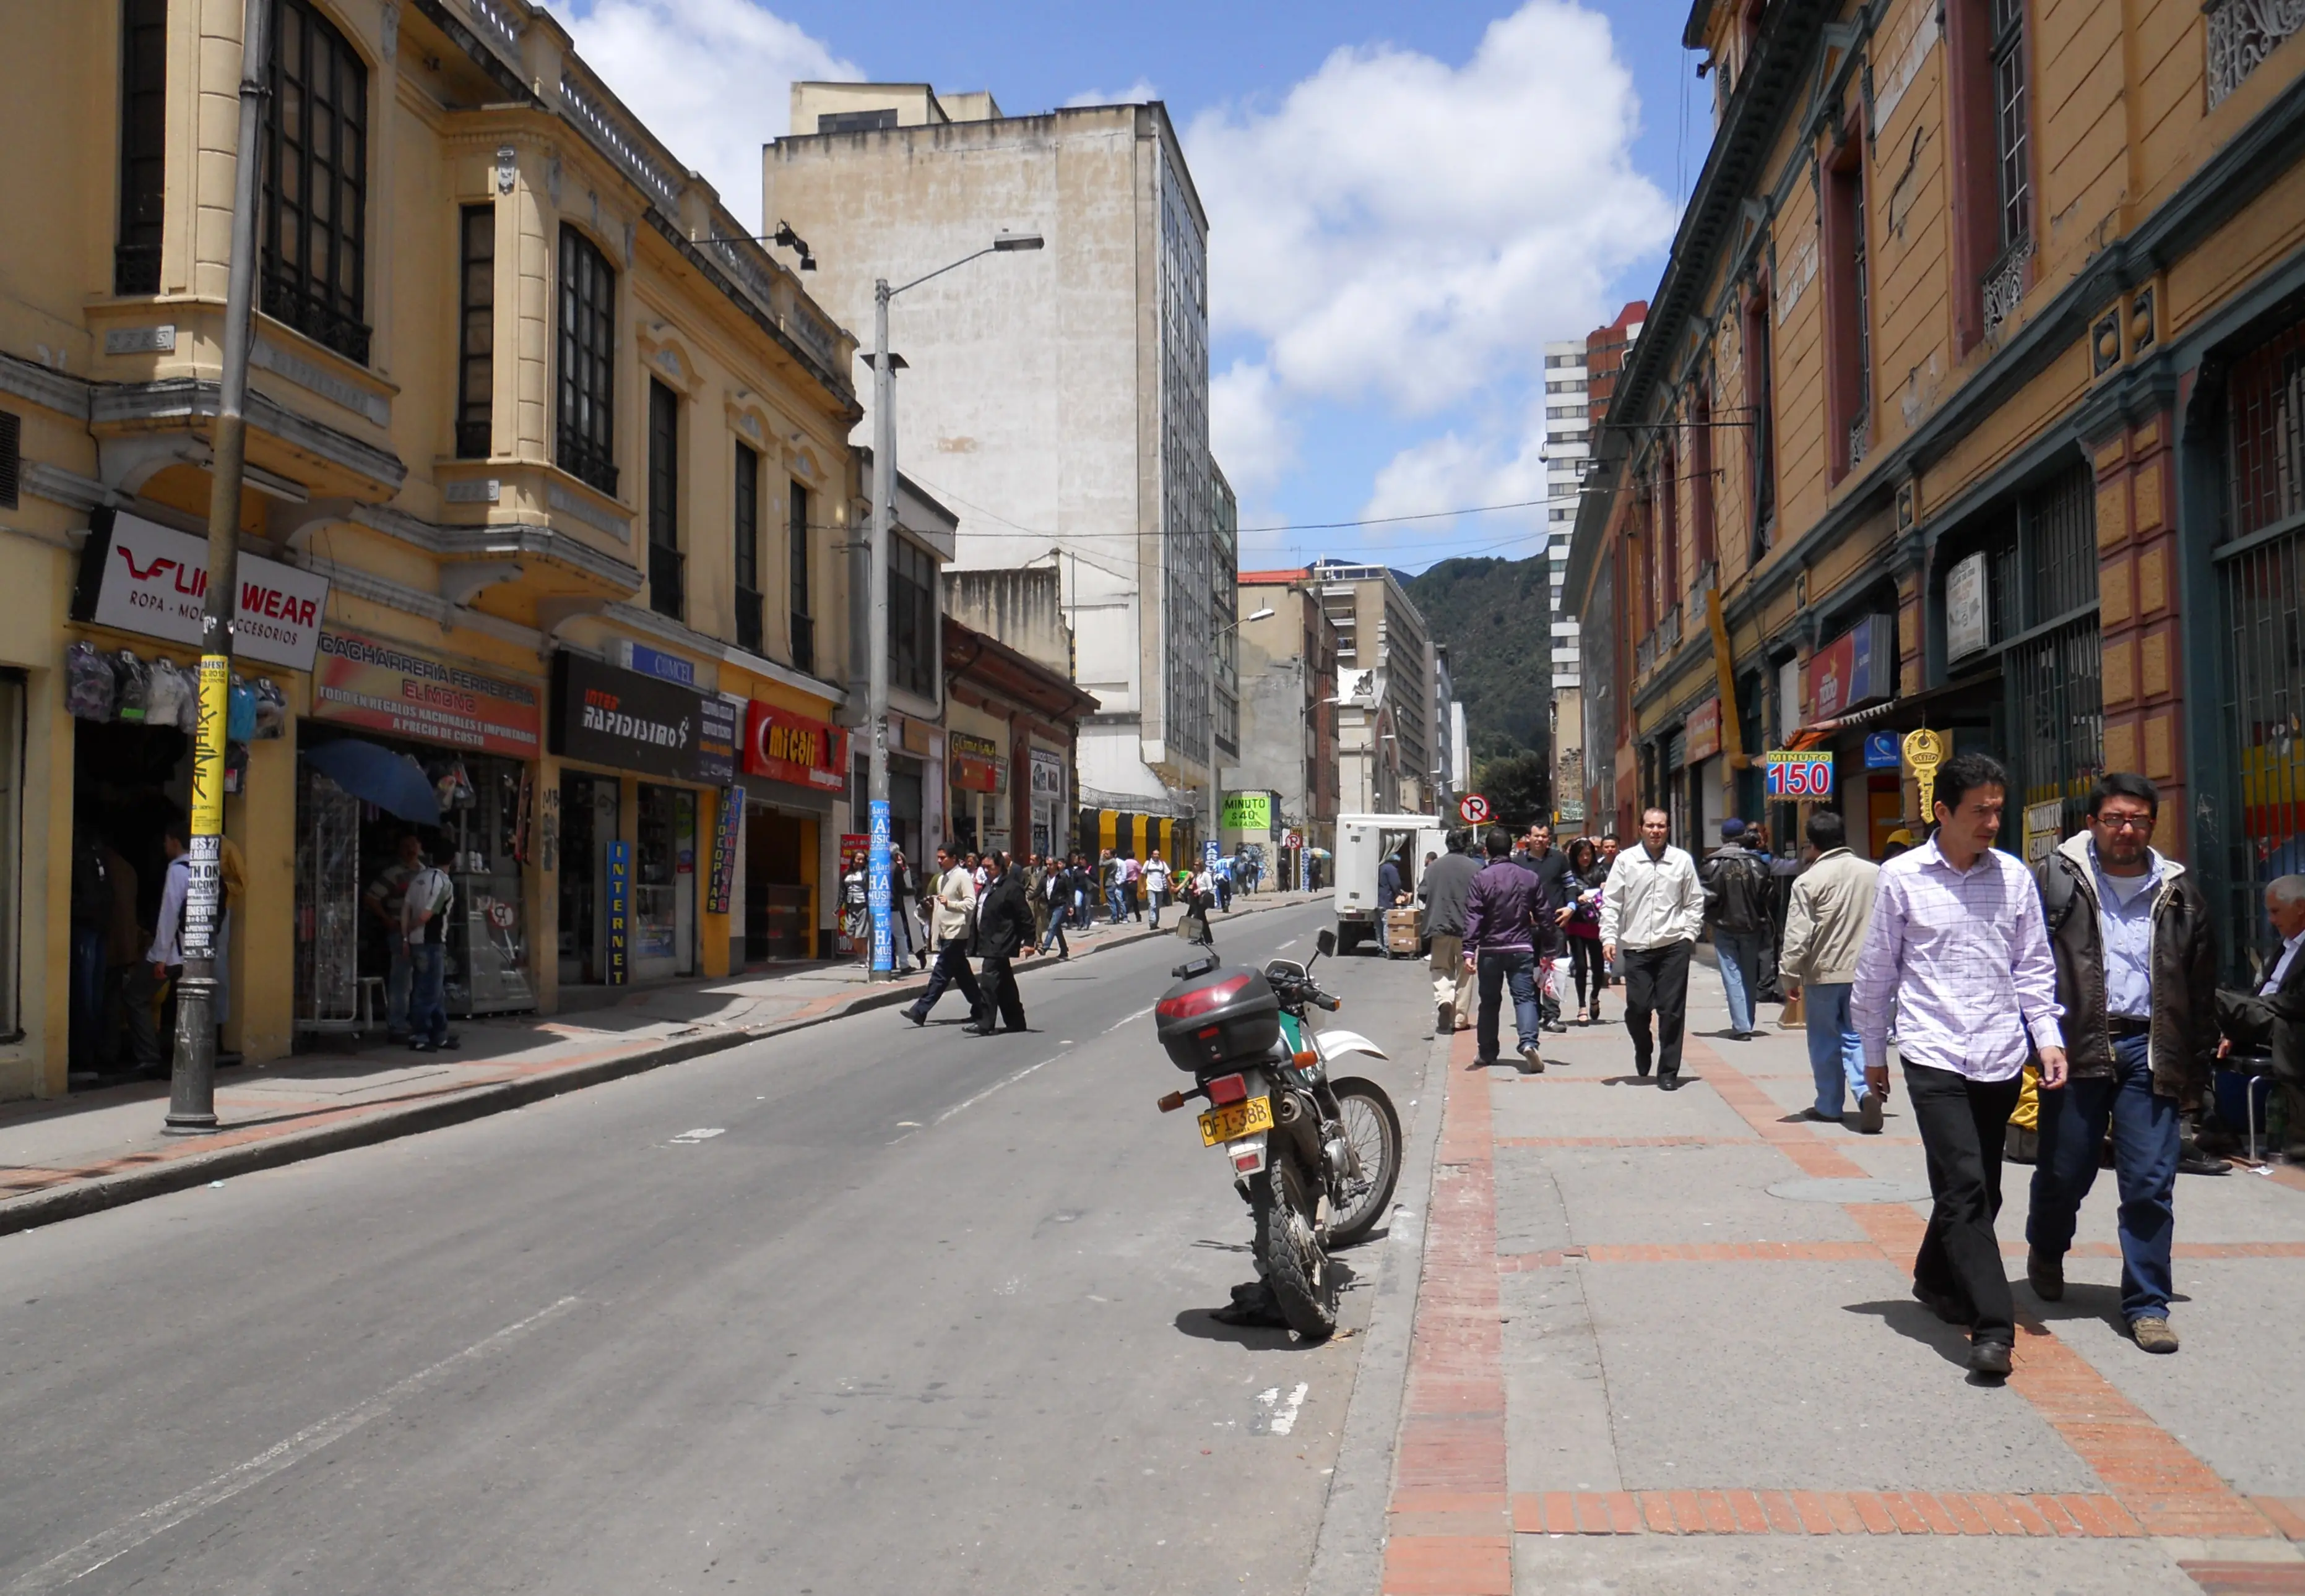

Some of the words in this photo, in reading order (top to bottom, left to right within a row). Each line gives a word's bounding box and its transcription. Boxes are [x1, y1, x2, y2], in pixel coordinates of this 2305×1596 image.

[130, 590, 163, 611] ROPA
[236, 618, 298, 646] CCESORIOS
[241, 582, 316, 628] WEAR
[319, 686, 350, 703] TODO
[354, 694, 368, 707] EN
[370, 698, 417, 717] REGALOS
[419, 708, 475, 731] NACIONALES
[484, 723, 537, 744] IMPORTADOS
[425, 684, 477, 715] MONO
[393, 718, 400, 730] A
[402, 720, 438, 737] PRECIO
[441, 727, 452, 739] DE
[454, 730, 484, 746] COSTO
[1770, 753, 1830, 762] MINUTO
[1768, 762, 1830, 795] 150
[1225, 798, 1265, 809] MINUTO
[708, 785, 731, 911] FOTOCOPIAS
[612, 845, 624, 984] INTERNET
[1235, 1103, 1267, 1127] 38B
